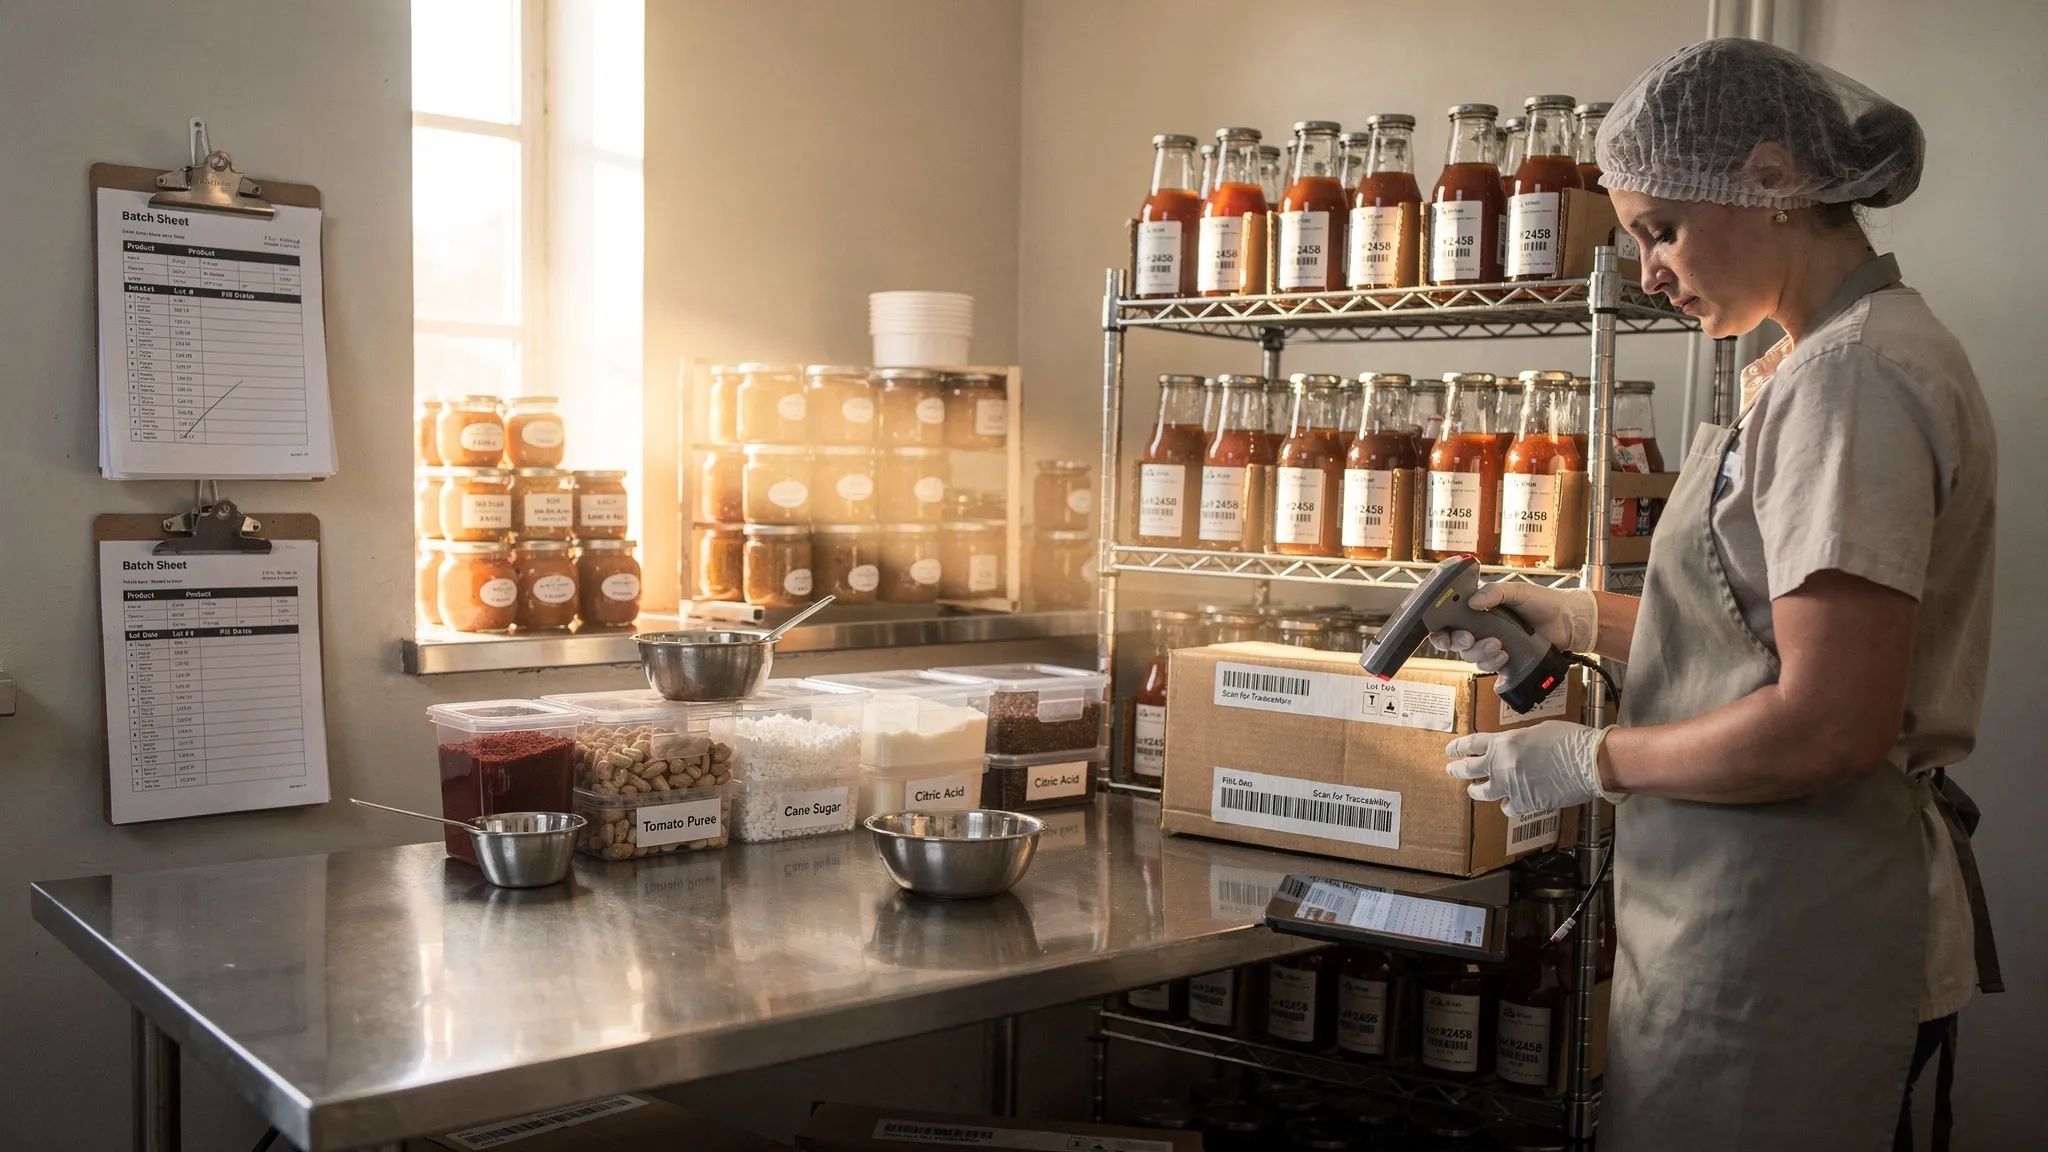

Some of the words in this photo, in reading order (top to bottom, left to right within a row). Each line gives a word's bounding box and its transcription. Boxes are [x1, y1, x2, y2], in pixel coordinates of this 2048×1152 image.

[122, 210, 154, 223] Batch
[157, 213, 190, 227] Sheet
[122, 560, 154, 571] Batch
[156, 560, 188, 571] Sheet
[127, 592, 155, 600] Product
[1222, 689, 1239, 698] Scan
[1239, 691, 1250, 700] for
[1034, 776, 1058, 788] Citric
[1060, 774, 1079, 786] Acid
[915, 789, 941, 803] Citric
[943, 786, 965, 799] Acid
[1313, 789, 1331, 799] Scan
[1332, 791, 1343, 801] for
[784, 804, 811, 818] Cane
[813, 801, 842, 817] Sugar
[643, 818, 684, 833] Tomato
[687, 815, 717, 829] Puree
